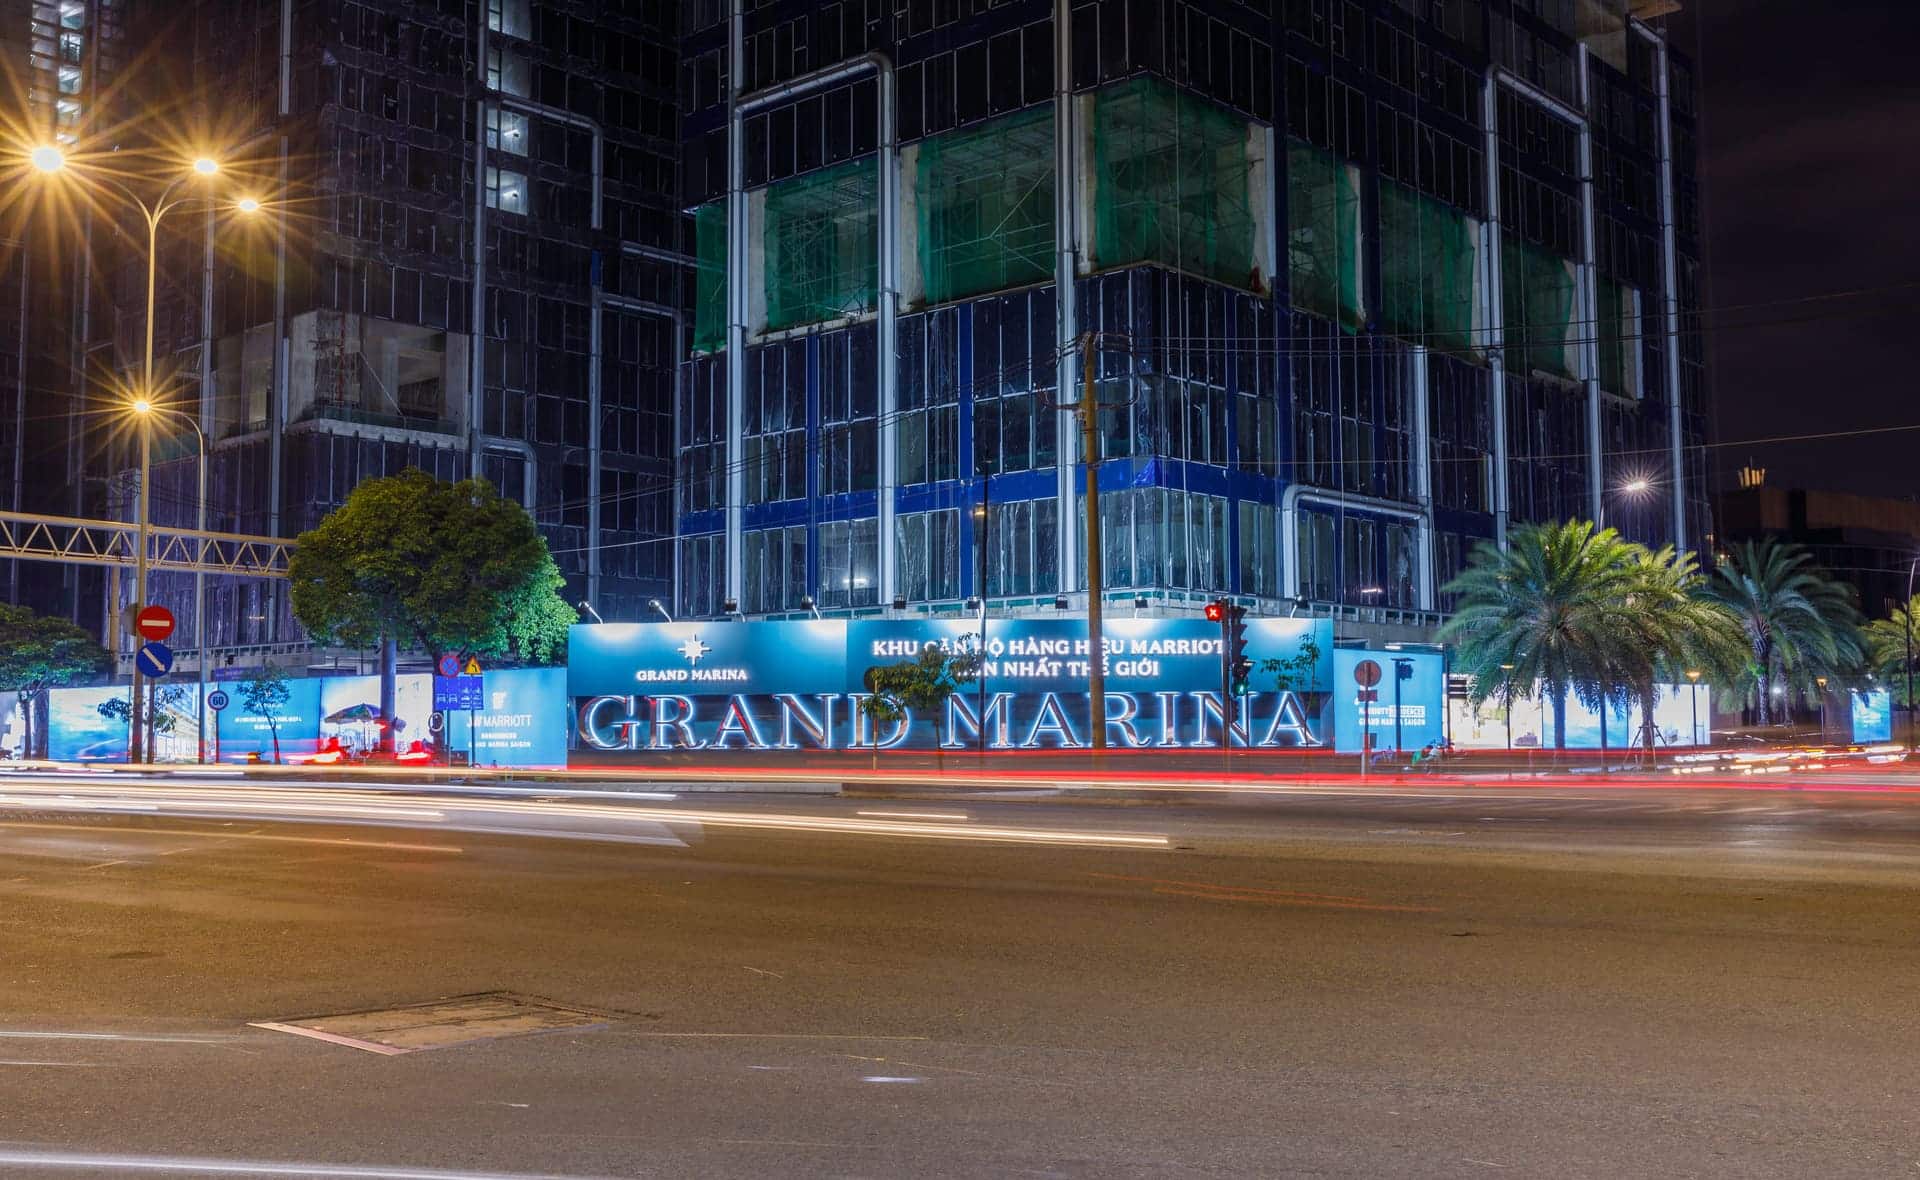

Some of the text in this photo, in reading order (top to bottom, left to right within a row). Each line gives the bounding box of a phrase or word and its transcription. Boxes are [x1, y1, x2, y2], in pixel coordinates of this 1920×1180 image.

[873, 640, 918, 656] KHU
[1009, 636, 1072, 655] HÀNG
[636, 669, 748, 681] GRAND MARINA
[1003, 657, 1062, 677] NHẤT
[1115, 657, 1160, 677] GIỚI
[212, 696, 224, 706] 60
[483, 714, 533, 728] MARRIOTT
[579, 692, 1324, 750] GRAND MARINA
